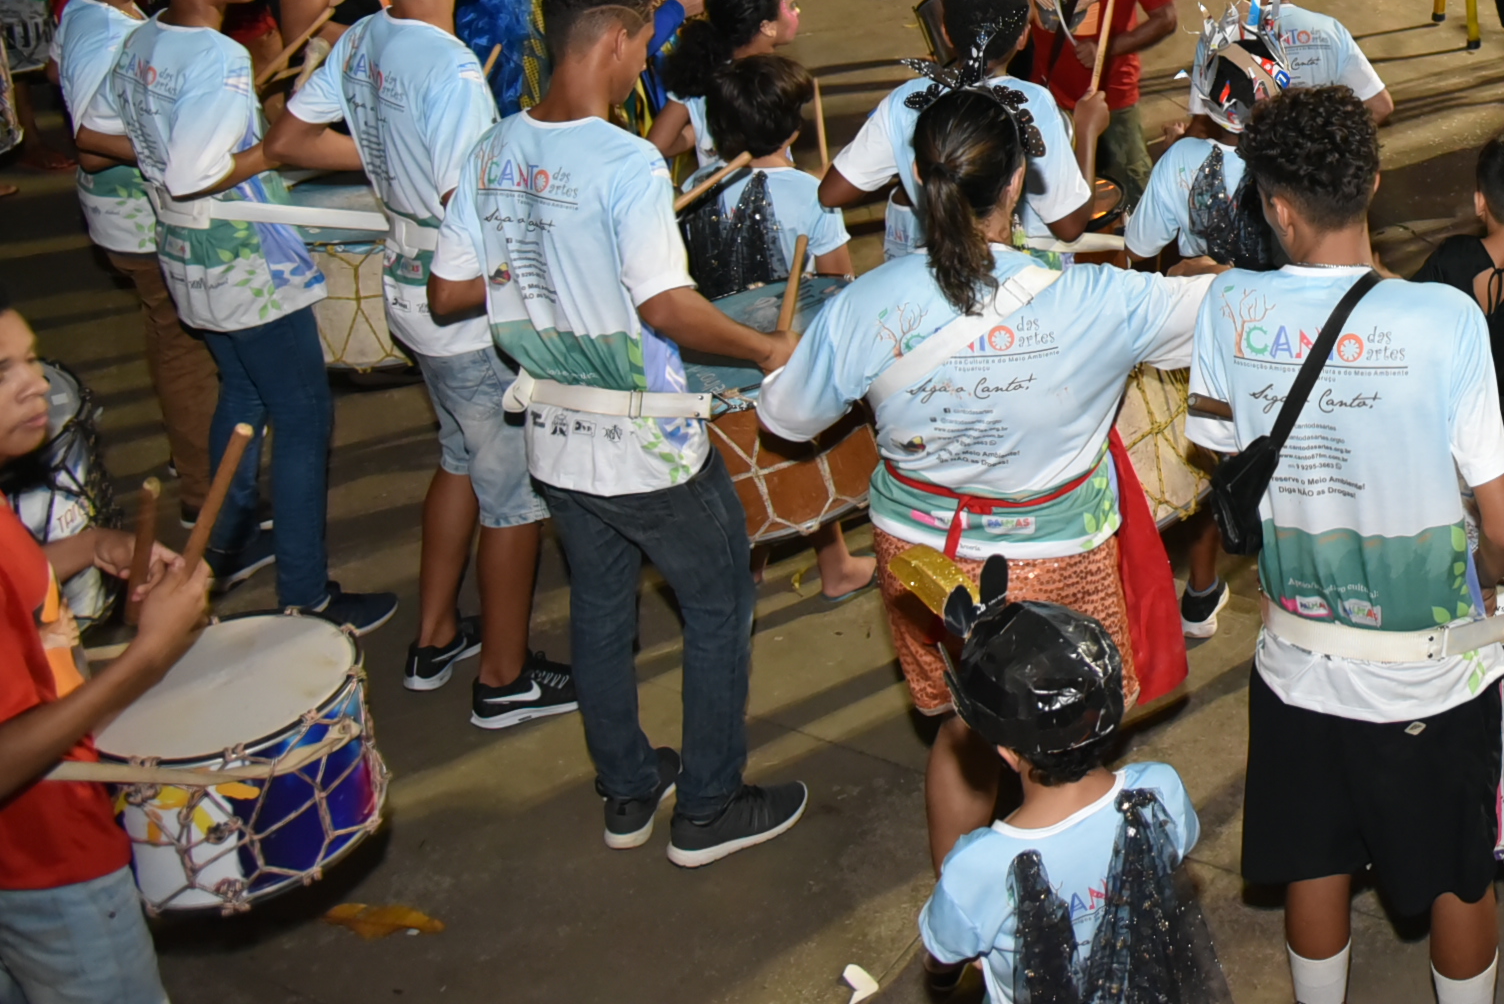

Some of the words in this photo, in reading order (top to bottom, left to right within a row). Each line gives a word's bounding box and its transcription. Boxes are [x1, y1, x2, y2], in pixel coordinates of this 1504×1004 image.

[487, 159, 549, 193] CANTO
[552, 166, 570, 183] das
[549, 184, 578, 198] artes
[1017, 316, 1039, 331] das
[1019, 331, 1055, 347] artes
[1367, 326, 1392, 344] das
[1028, 350, 1059, 360] Ambiente
[1366, 346, 1405, 361] artes
[1270, 365, 1295, 373] Amigos
[906, 378, 949, 403] Siga
[974, 373, 1037, 399] Canto!
[1319, 388, 1382, 413] Canto!
[1308, 477, 1327, 485] Meio
[1279, 486, 1296, 494] Diga
